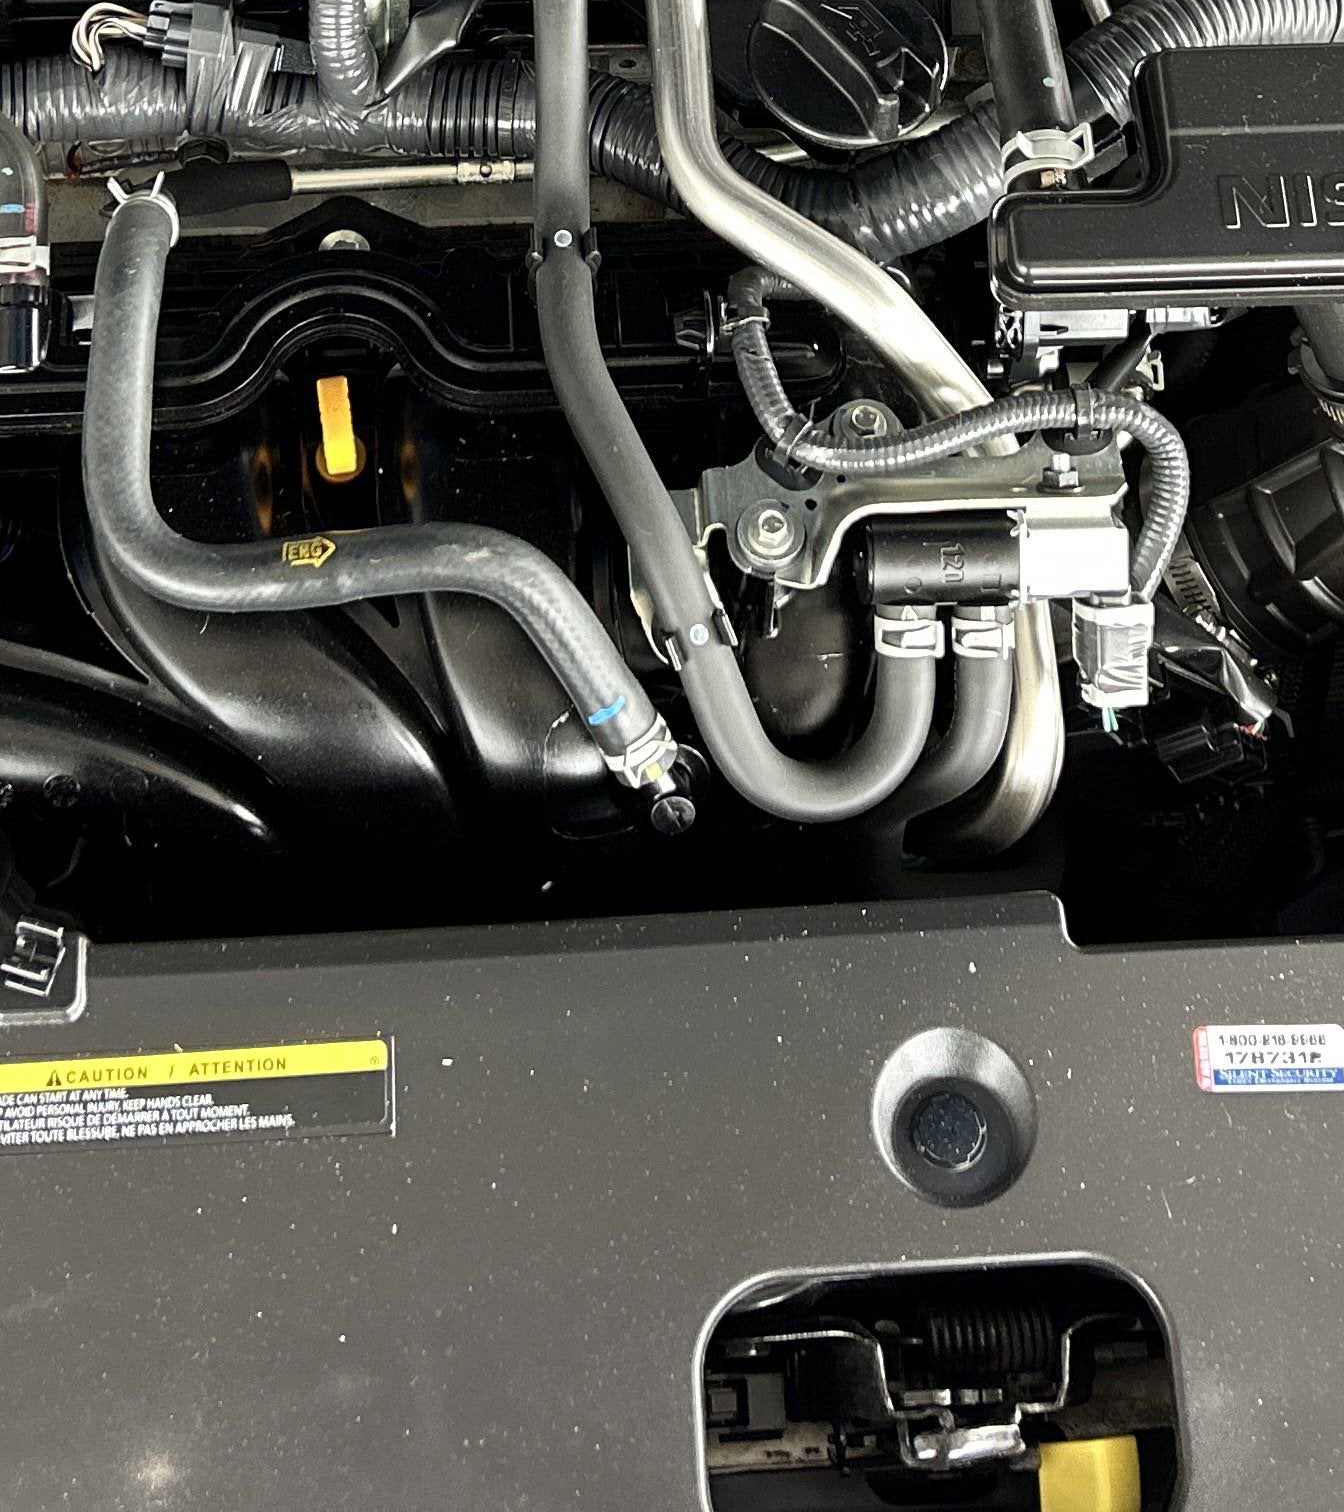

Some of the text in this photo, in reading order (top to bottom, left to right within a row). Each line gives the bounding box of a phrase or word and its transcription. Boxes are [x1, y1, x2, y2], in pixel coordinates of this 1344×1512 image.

[288, 541, 323, 561] ENG
[67, 1066, 147, 1084] CAUTION
[189, 1058, 286, 1076] ATTENTION
[1270, 1067, 1338, 1078] SECURITY
[5, 1106, 35, 1118] AVOID
[37, 1103, 85, 1116] PERSONAL
[123, 1099, 146, 1111] KEEP
[147, 1096, 181, 1109] HANDS
[182, 1094, 215, 1107] CLEAR.
[16, 1092, 37, 1105] CAN
[39, 1090, 67, 1103] START
[69, 1090, 80, 1101] AT
[83, 1088, 102, 1100] ANY
[48, 1115, 85, 1129] RISQUE
[87, 1114, 101, 1125] DE
[171, 1107, 200, 1120] TOUT
[201, 1104, 250, 1118] MOMENT.
[30, 1130, 65, 1144] TOUTE
[121, 1126, 136, 1137] NE
[138, 1124, 157, 1136] PAS
[158, 1122, 174, 1135] EN
[175, 1119, 238, 1134] APPROCHER
[239, 1117, 256, 1130] LES
[258, 1114, 296, 1129] MAINS.
